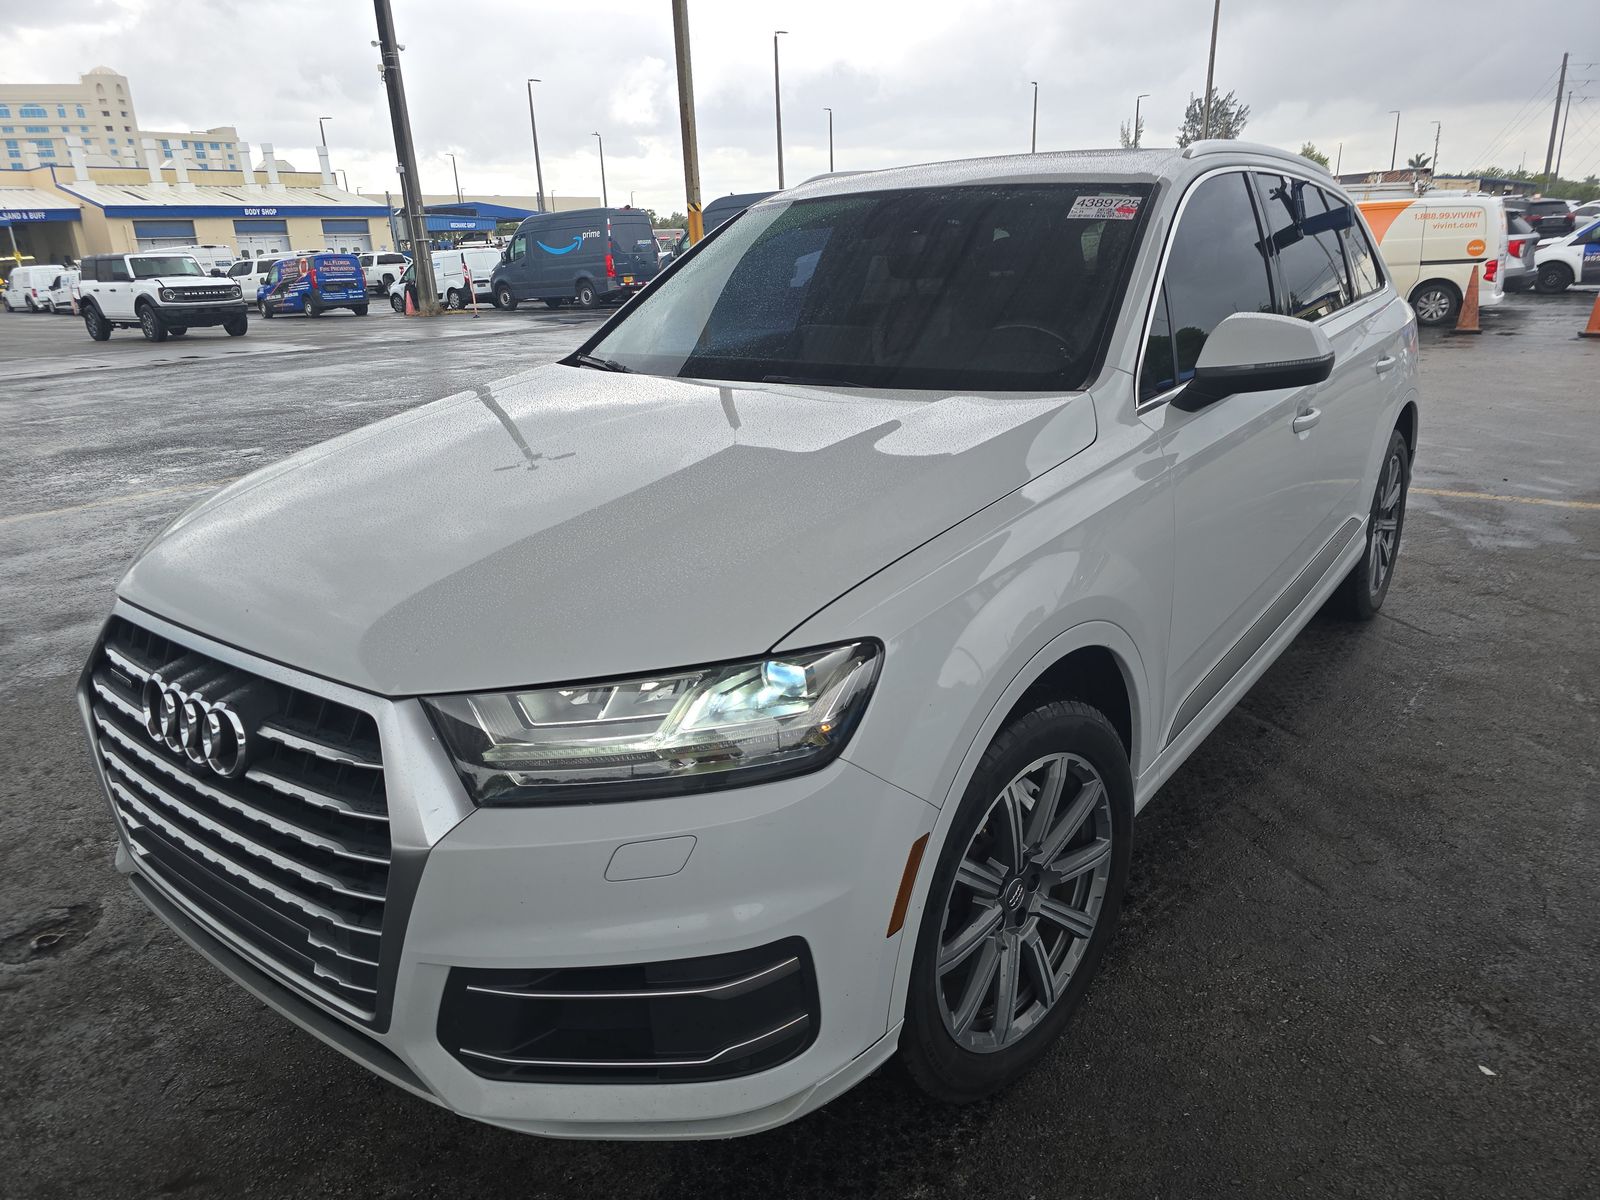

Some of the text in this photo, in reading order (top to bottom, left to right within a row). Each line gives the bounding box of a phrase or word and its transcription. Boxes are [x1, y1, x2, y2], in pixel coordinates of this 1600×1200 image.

[1077, 198, 1140, 208] 4389725
[1415, 211, 1482, 220] 1.888.99.VIVINT
[582, 230, 600, 240] prime
